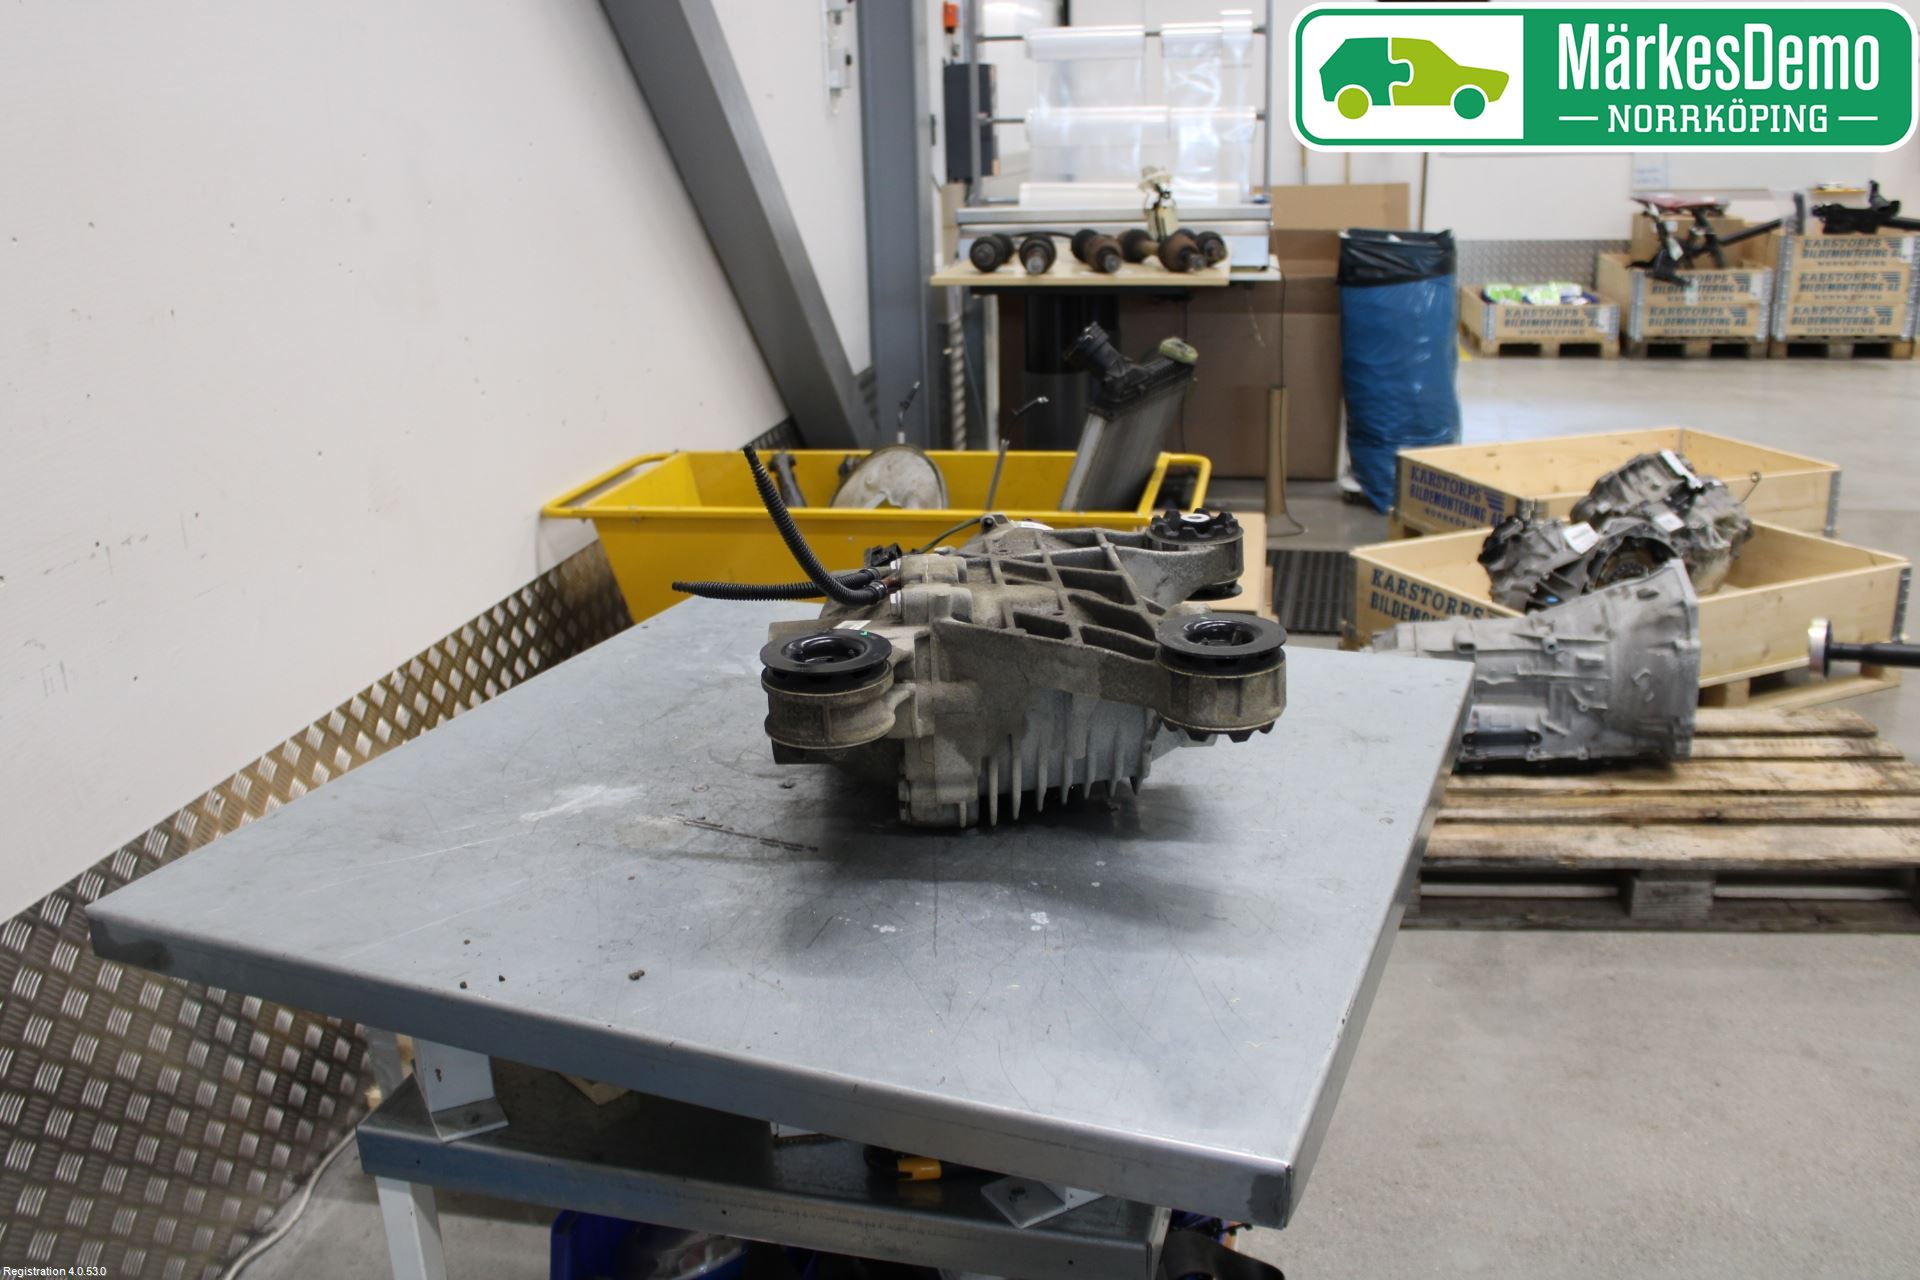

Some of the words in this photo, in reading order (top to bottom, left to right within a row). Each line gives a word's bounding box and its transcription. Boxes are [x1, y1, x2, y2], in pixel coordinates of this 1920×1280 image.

[1804, 239, 1881, 249] KARSTORPS
[1801, 272, 1879, 281] KARSTORPS
[1504, 309, 1579, 318] KARSTORPS
[1650, 307, 1724, 316] KARSTORPS
[1794, 306, 1870, 315] KARSTORPS
[1411, 465, 1481, 502] KARSTORPS
[1371, 567, 1484, 620] KARSTORPS
